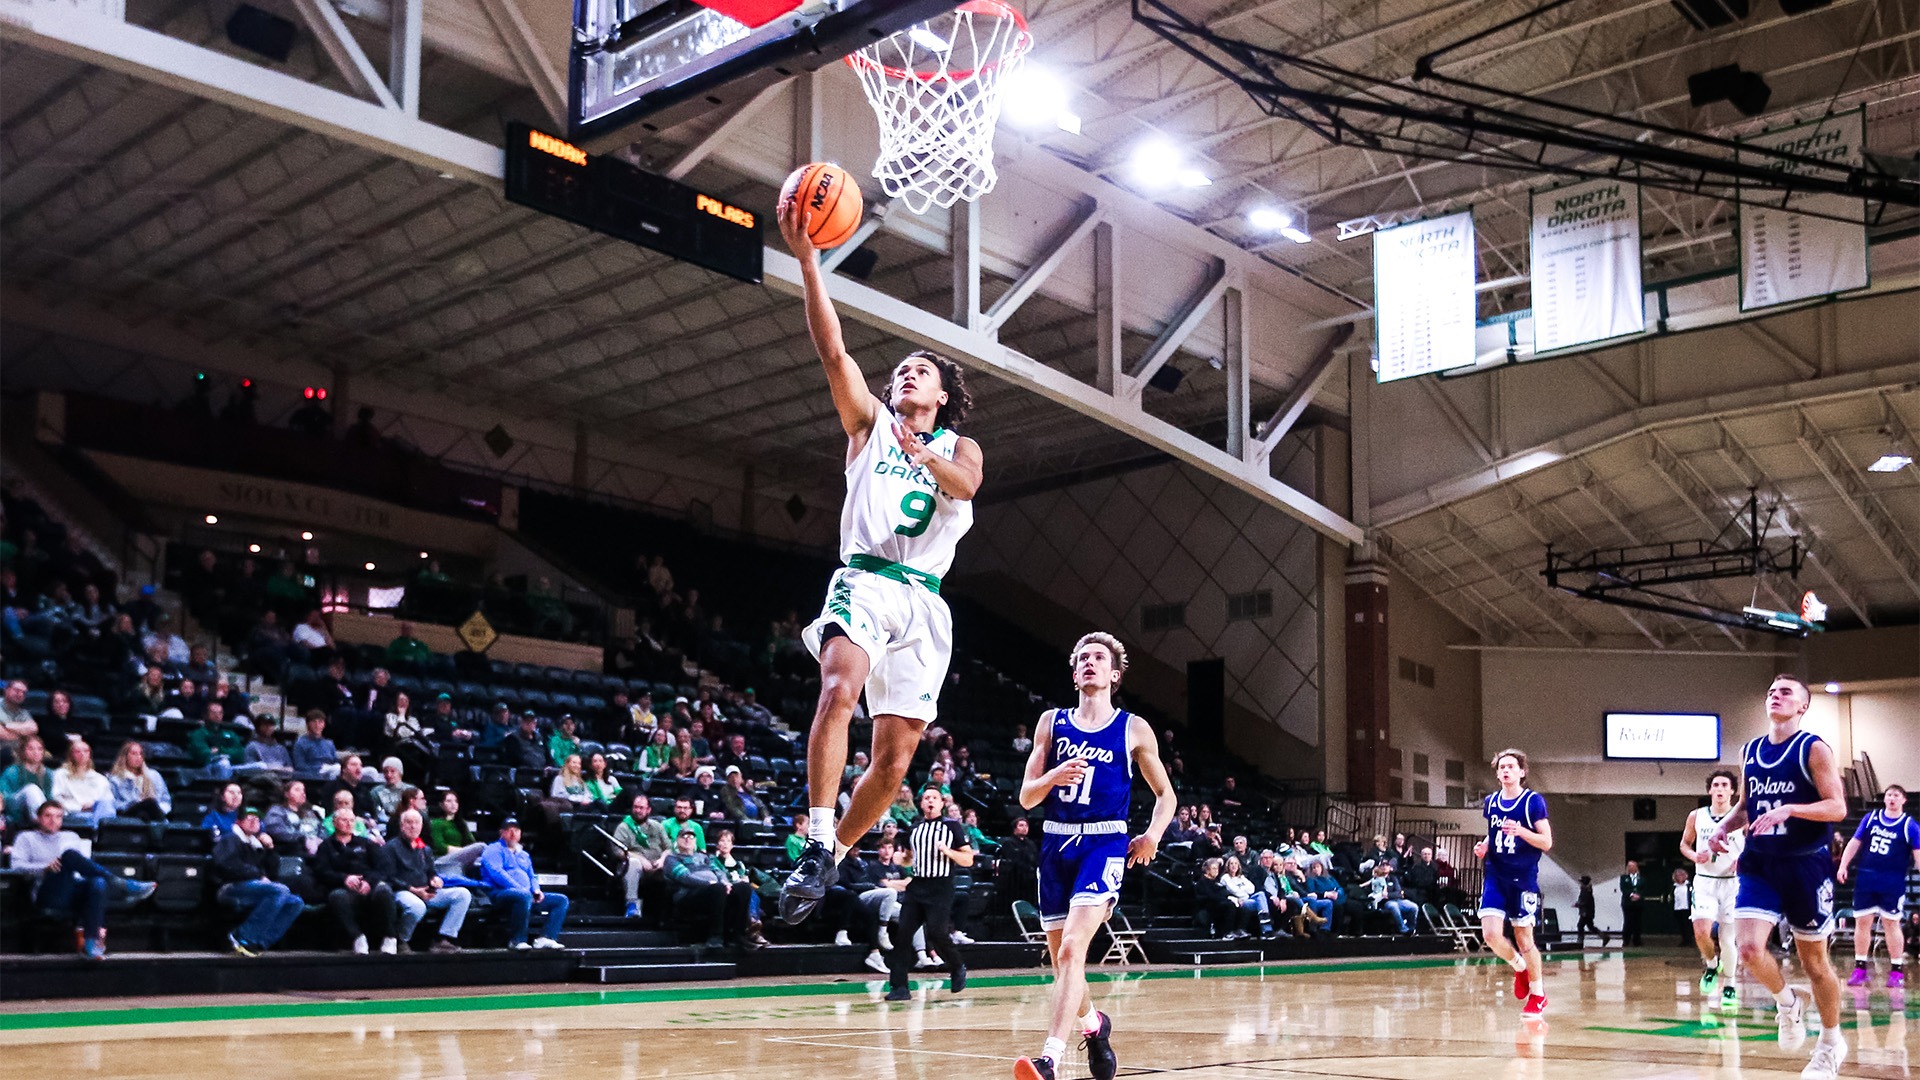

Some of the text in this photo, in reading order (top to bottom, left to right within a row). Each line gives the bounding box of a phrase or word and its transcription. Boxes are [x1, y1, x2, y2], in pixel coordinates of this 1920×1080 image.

[811, 173, 834, 211] NCAA
[1555, 184, 1620, 211] NORTH
[696, 193, 755, 229] POLARS
[1547, 199, 1626, 228] DAKOTA
[894, 490, 937, 538] 9
[1056, 736, 1114, 763] Polars
[1748, 776, 1796, 798] Polars
[1870, 825, 1897, 839] Polars
[1870, 836, 1892, 855] 55
